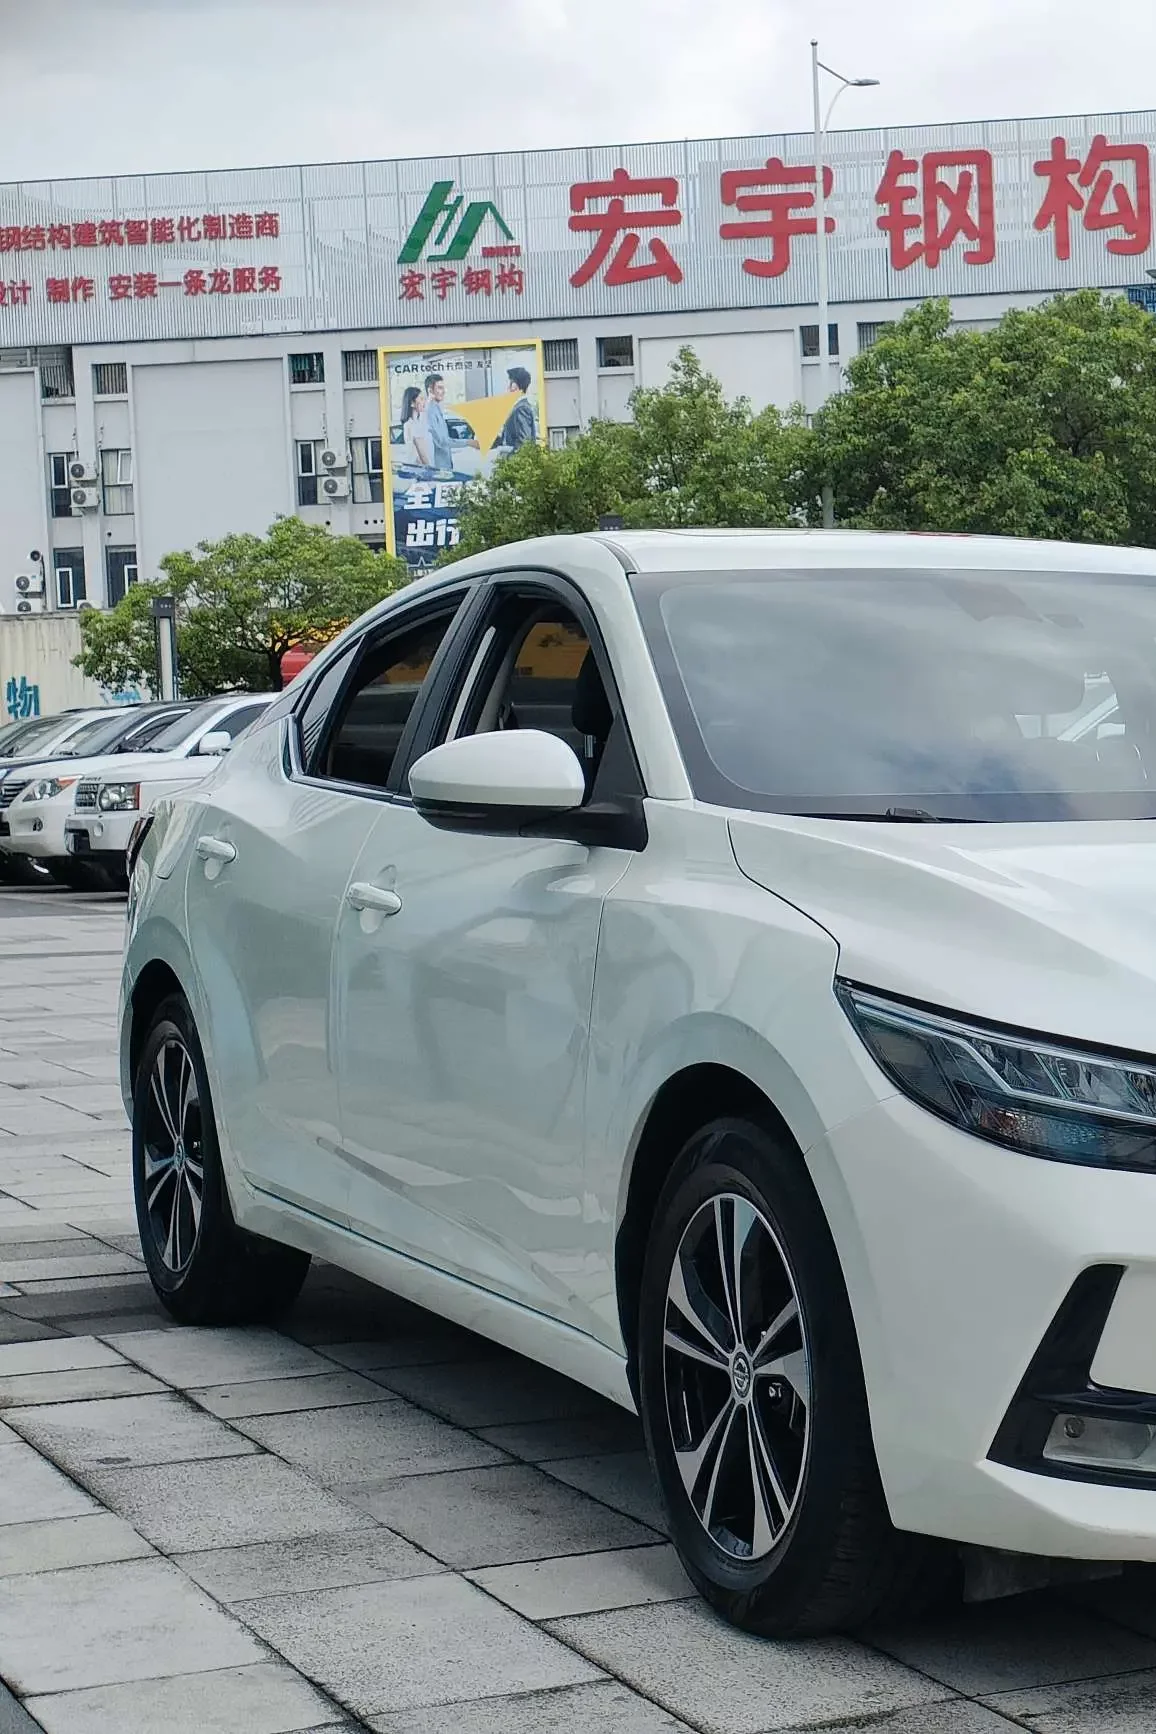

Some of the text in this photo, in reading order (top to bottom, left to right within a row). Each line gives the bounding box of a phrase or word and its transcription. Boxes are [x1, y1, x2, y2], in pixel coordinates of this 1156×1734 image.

[568, 133, 1152, 288] 宏宇钢构
[0, 211, 280, 253] 钢结构建筑智能化制造商
[107, 266, 283, 301] 安装一条龙服务
[398, 263, 524, 301] 宏宇钢构
[405, 518, 461, 547] 出行
[6, 676, 41, 719] 物
